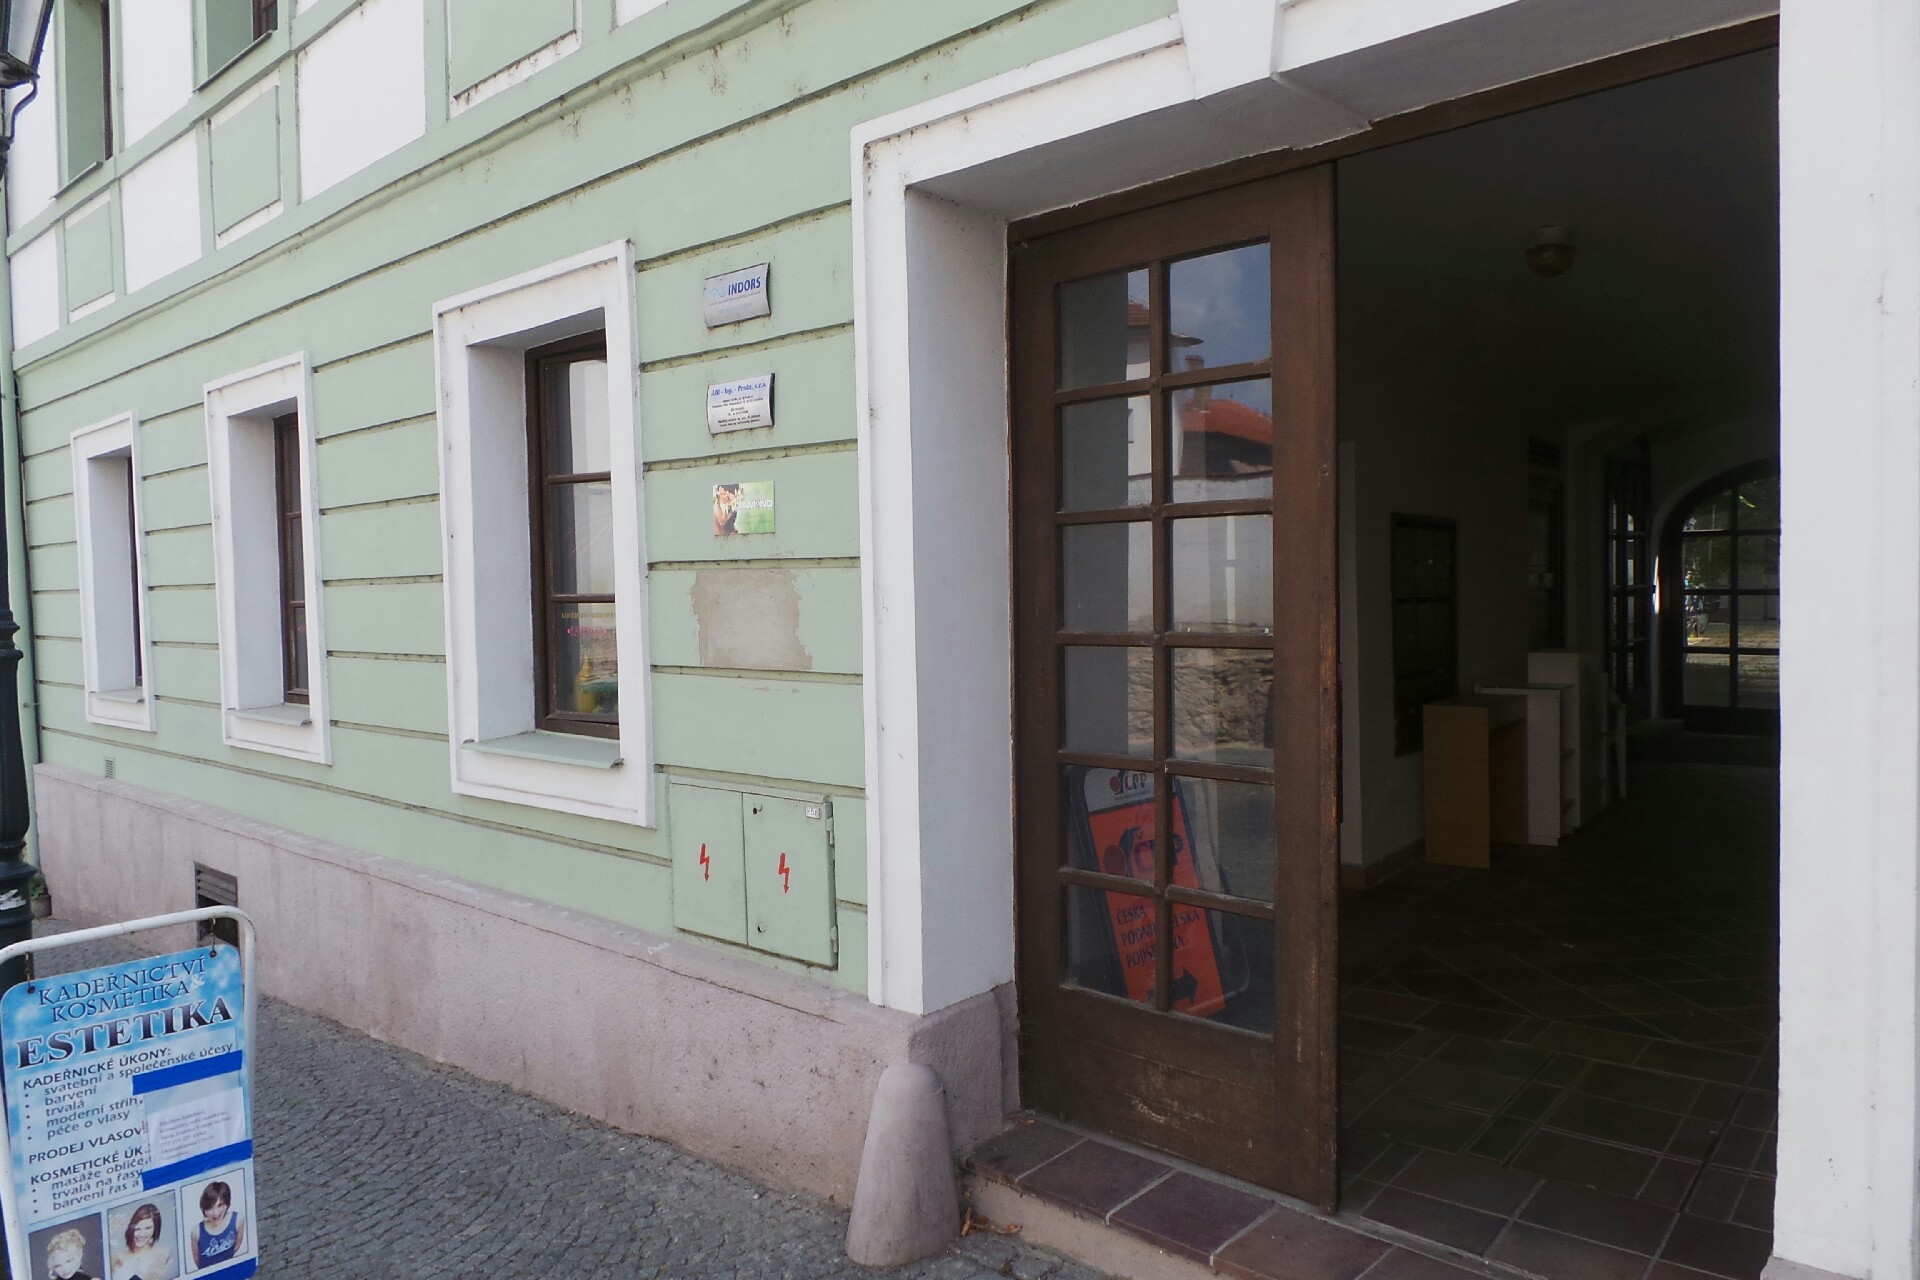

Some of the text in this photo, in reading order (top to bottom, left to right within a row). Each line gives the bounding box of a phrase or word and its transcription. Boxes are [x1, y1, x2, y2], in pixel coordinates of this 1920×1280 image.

[1117, 904, 1147, 926] ČESKÁ
[38, 954, 206, 1006] KADEŘNICTVÍ
[52, 980, 189, 1024] KOSMETIKA
[16, 998, 232, 1069] ESTETIKA
[23, 1047, 171, 1090] KADEŘNICKÉ ÚKONY:
[44, 1042, 233, 1095] svatební a společenské účesy
[44, 1085, 97, 1106] barvení
[46, 1100, 85, 1117] trvalá
[46, 1104, 104, 1128] moderní
[47, 1110, 130, 1141] péče o vlasy
[29, 1141, 84, 1164] PRODEJ
[31, 1149, 119, 1185] KOSMETICKÉ
[51, 1168, 101, 1190] masáže
[52, 1168, 142, 1201] trvalá na řasy
[53, 1179, 140, 1211] barvení řas a
